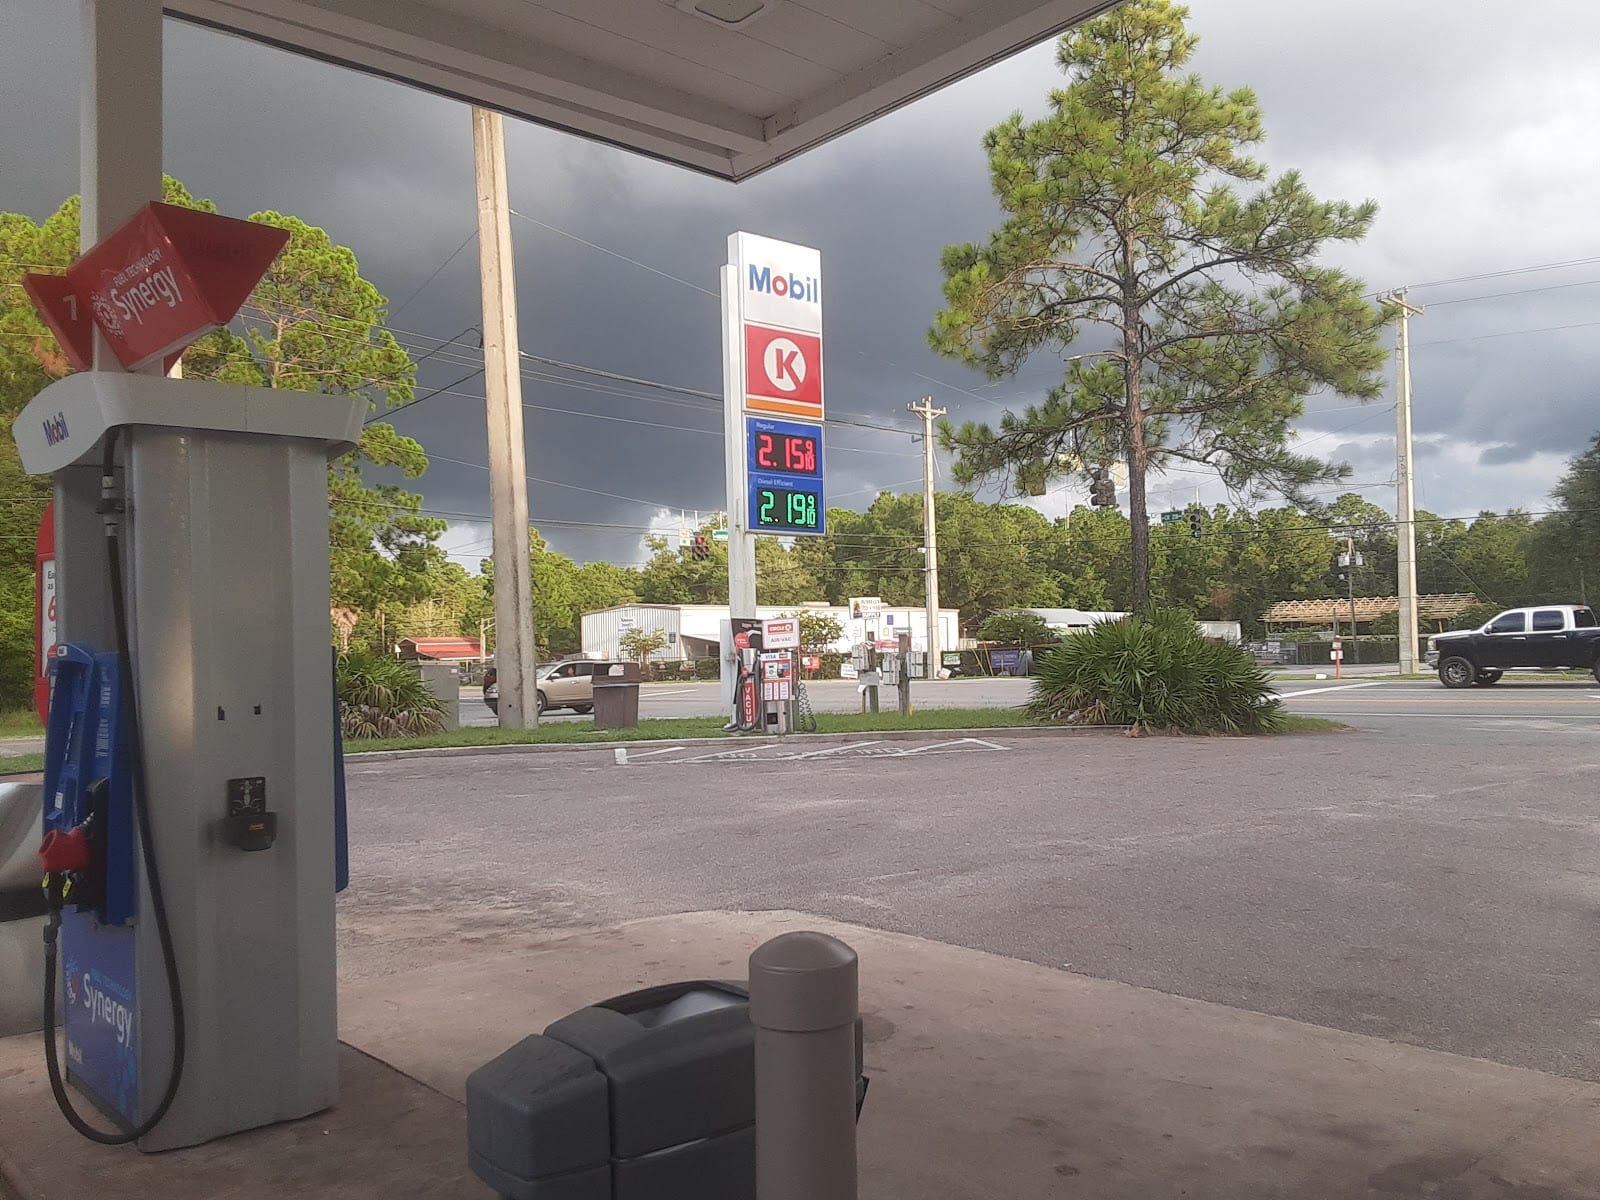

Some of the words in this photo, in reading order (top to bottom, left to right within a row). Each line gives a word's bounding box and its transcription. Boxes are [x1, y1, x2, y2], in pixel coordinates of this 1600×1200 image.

[113, 272, 129, 287] FUEL
[125, 248, 163, 278] TECHNOLOGY
[748, 263, 818, 304] Mobil
[62, 294, 77, 321] 7
[110, 265, 183, 325] Synergy
[775, 347, 801, 388] K
[42, 411, 70, 447] Mobil
[756, 422, 775, 430] Regular
[83, 973, 133, 1048] Synergy
